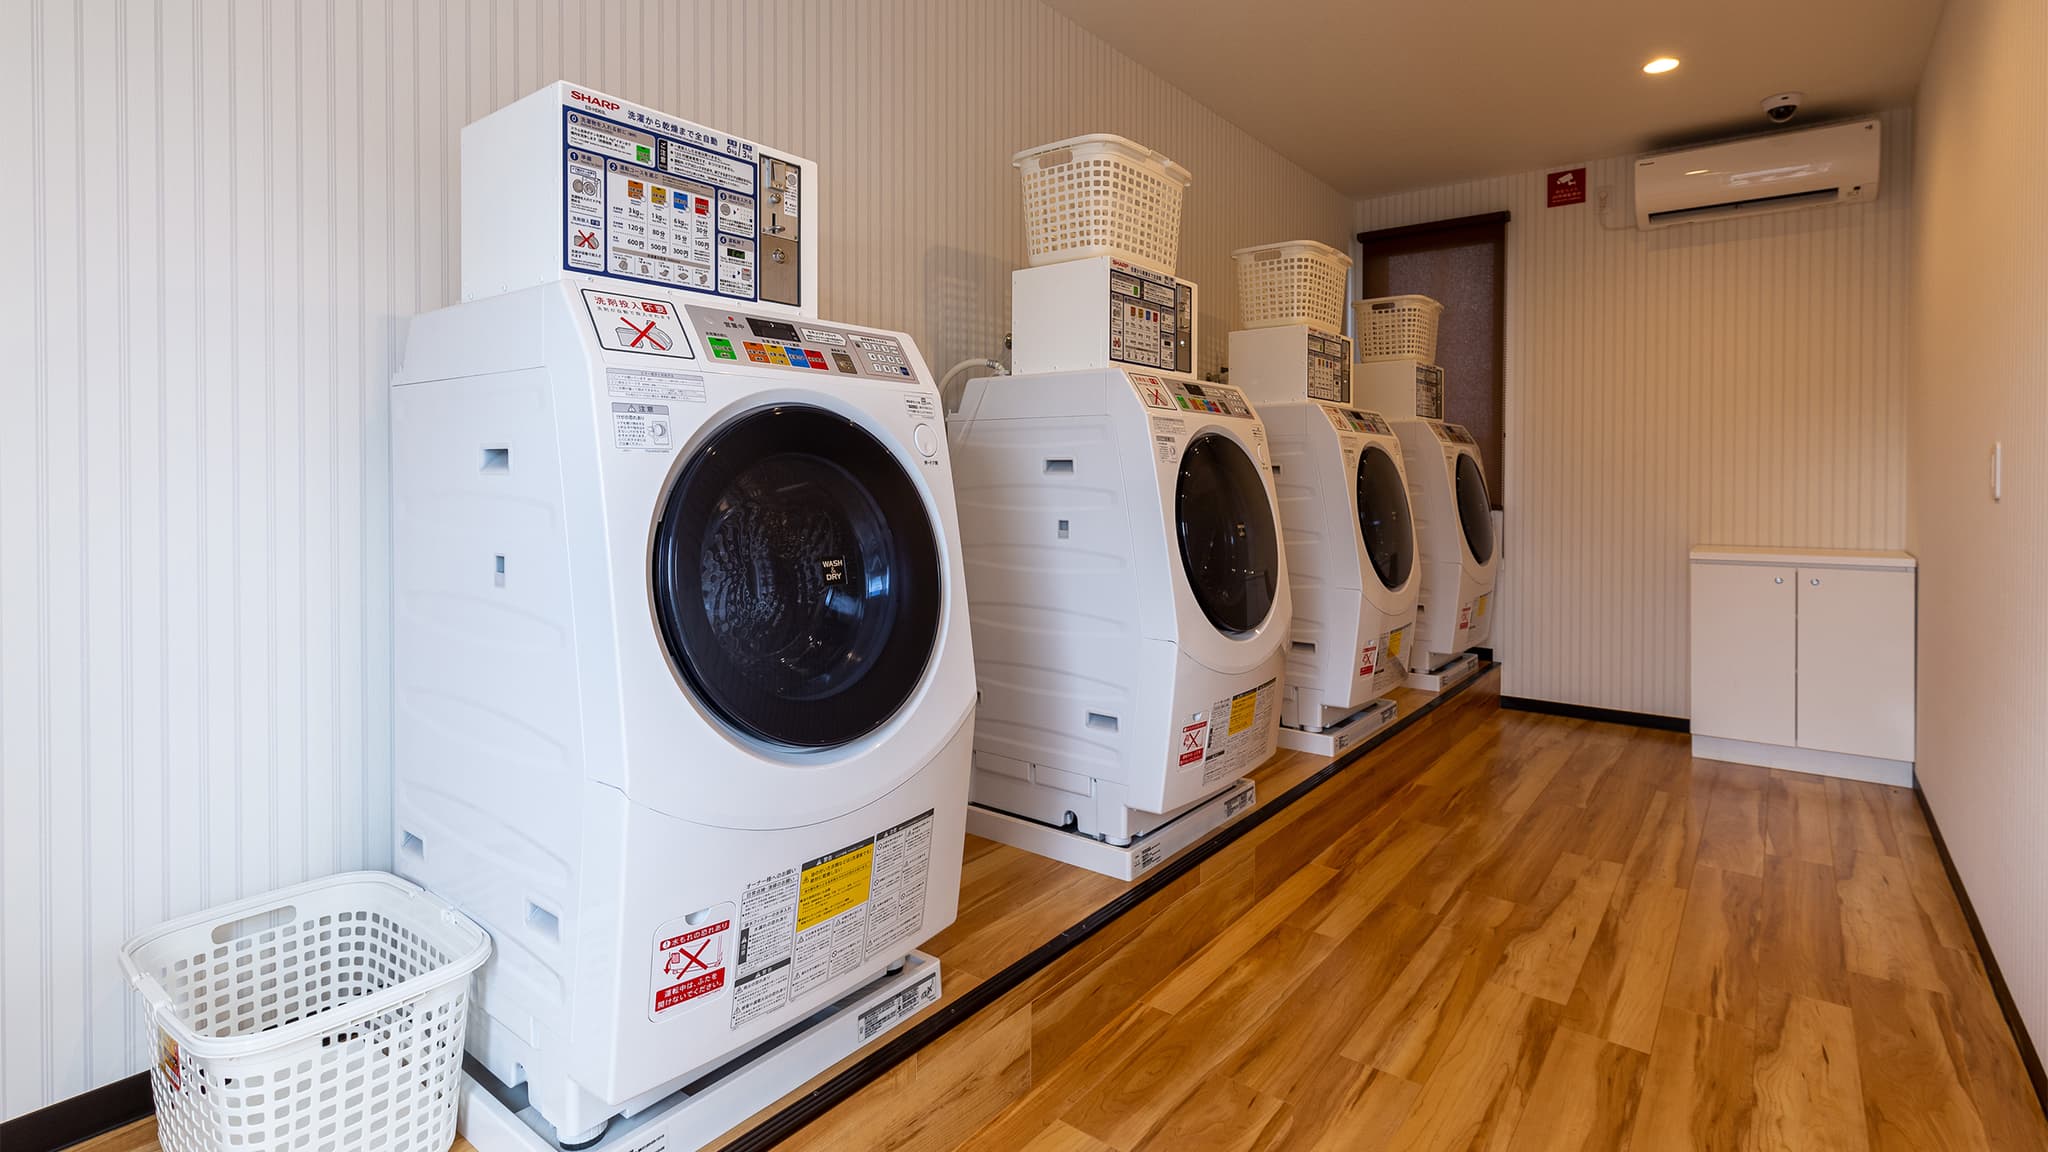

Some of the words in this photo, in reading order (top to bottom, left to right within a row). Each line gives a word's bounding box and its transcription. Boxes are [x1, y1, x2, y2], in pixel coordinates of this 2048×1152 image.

[571, 90, 620, 111] SHARP
[627, 110, 719, 146] 洗濯から乾燥まで全自動
[627, 223, 645, 233] 120分
[627, 238, 645, 249] 600円
[650, 243, 667, 254] 500円
[694, 240, 710, 250] 100円
[672, 247, 689, 257] 300円
[594, 296, 642, 311] 洗剤投入
[723, 321, 745, 330] 営業中
[822, 559, 843, 568] WASH
[830, 566, 837, 574] &
[826, 572, 842, 581] DRY
[671, 922, 729, 947] 水もれの恐れあり
